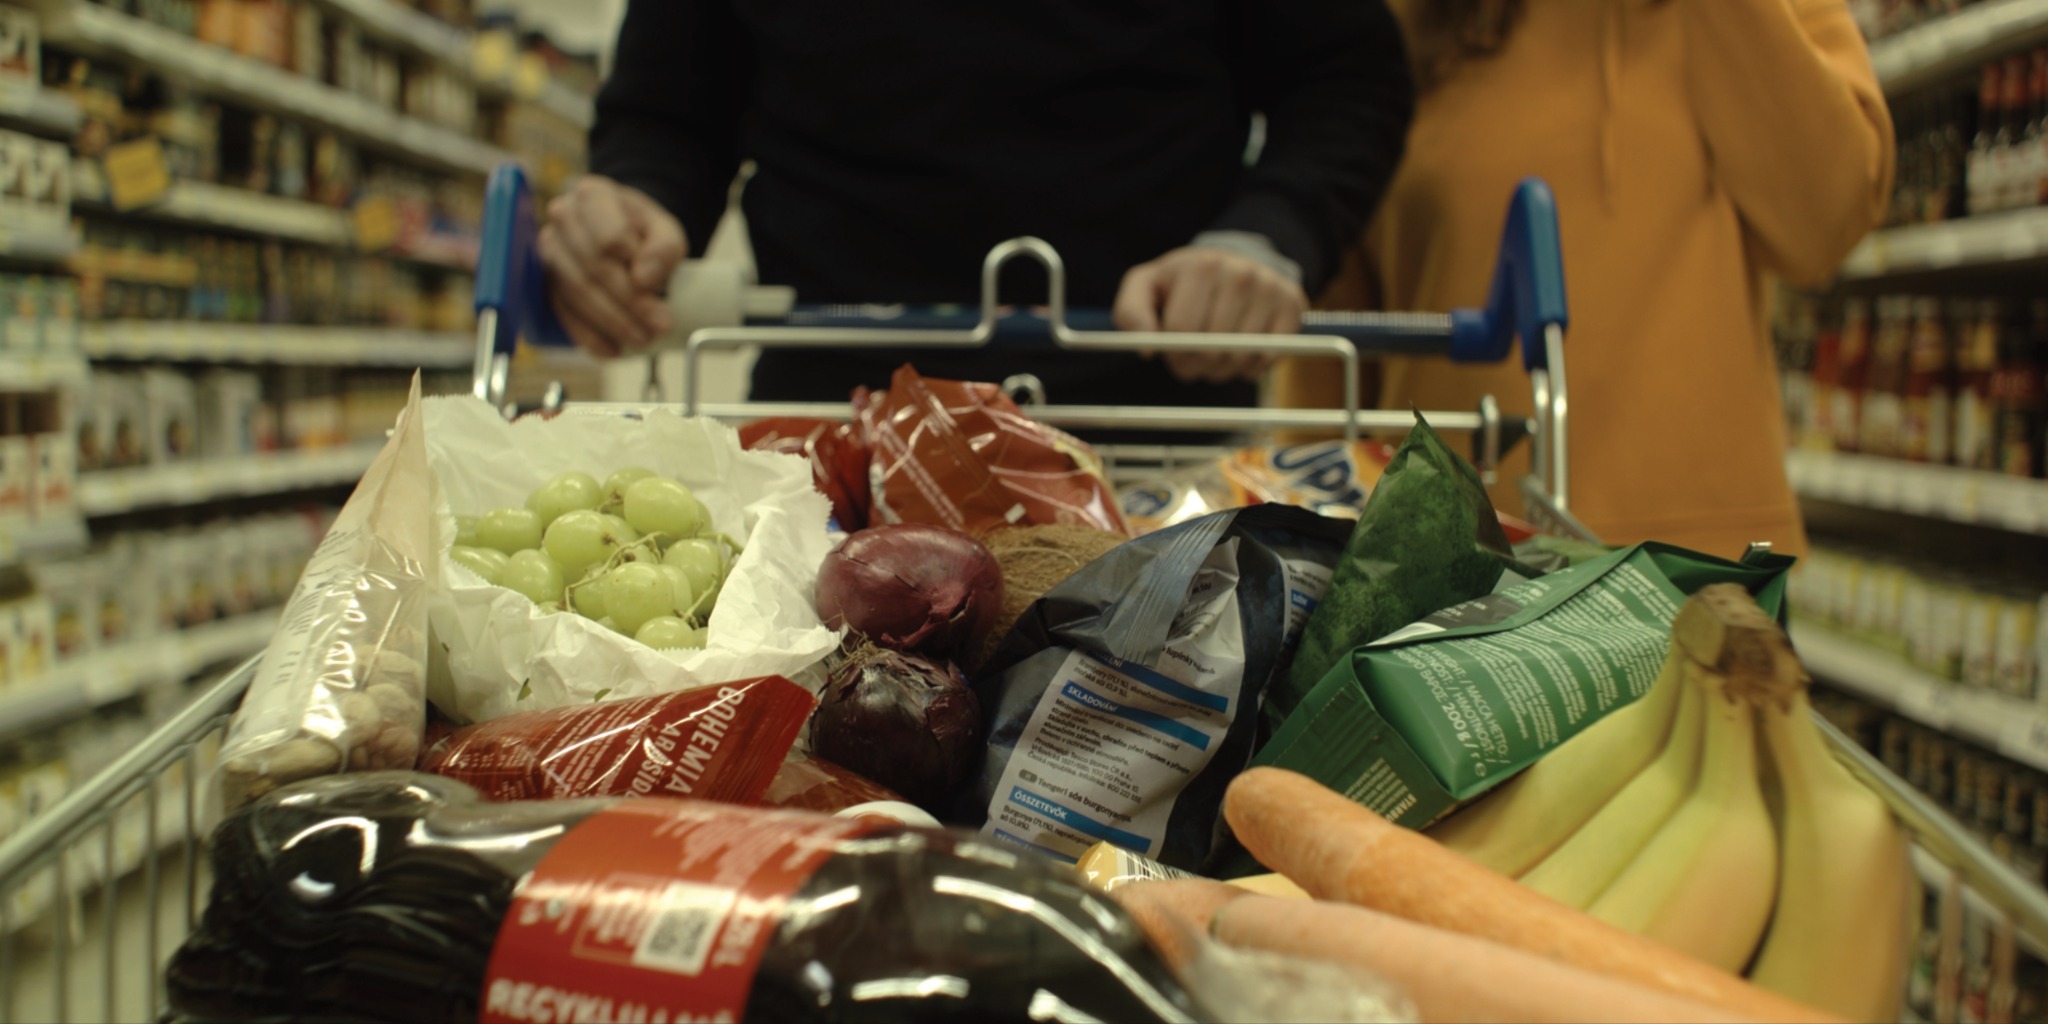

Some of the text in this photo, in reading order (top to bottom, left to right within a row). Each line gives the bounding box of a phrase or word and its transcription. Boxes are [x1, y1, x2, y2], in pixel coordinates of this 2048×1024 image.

[1432, 649, 1467, 677] WEIGHT:
[1067, 686, 1119, 713] SKLADOVÁNÍ
[664, 686, 746, 794] BOHEMIA
[1071, 751, 1088, 762] Tesco
[1038, 778, 1067, 795] Tengeri
[1068, 790, 1081, 801] sós
[1114, 777, 1130, 788] Praha
[1003, 805, 1032, 822] Burgonya
